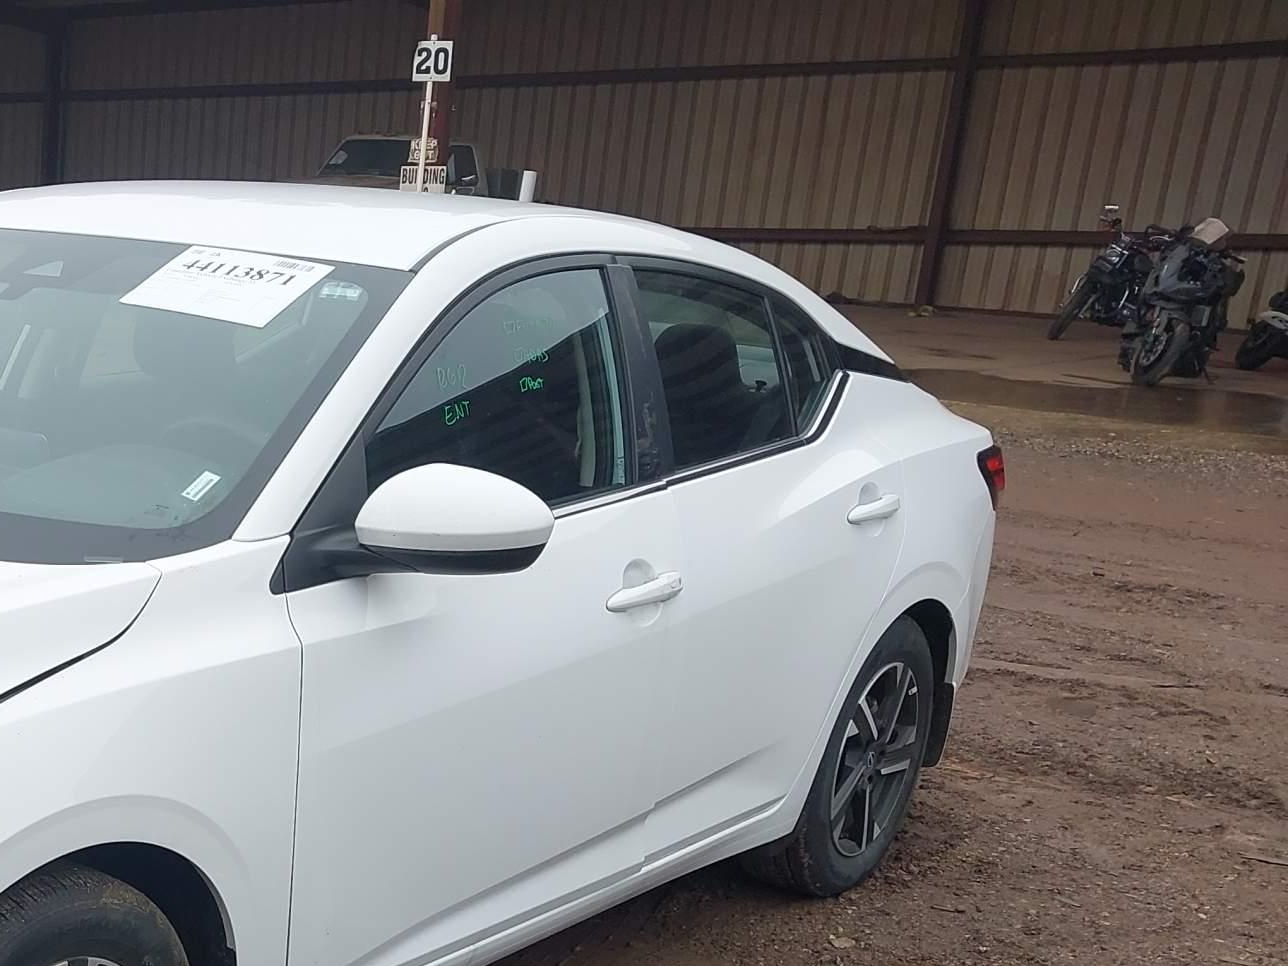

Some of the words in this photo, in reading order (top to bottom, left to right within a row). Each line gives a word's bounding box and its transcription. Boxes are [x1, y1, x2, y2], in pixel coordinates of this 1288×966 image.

[415, 47, 450, 75] 20
[401, 168, 445, 185] BUIDING
[182, 259, 296, 286] 44113871
